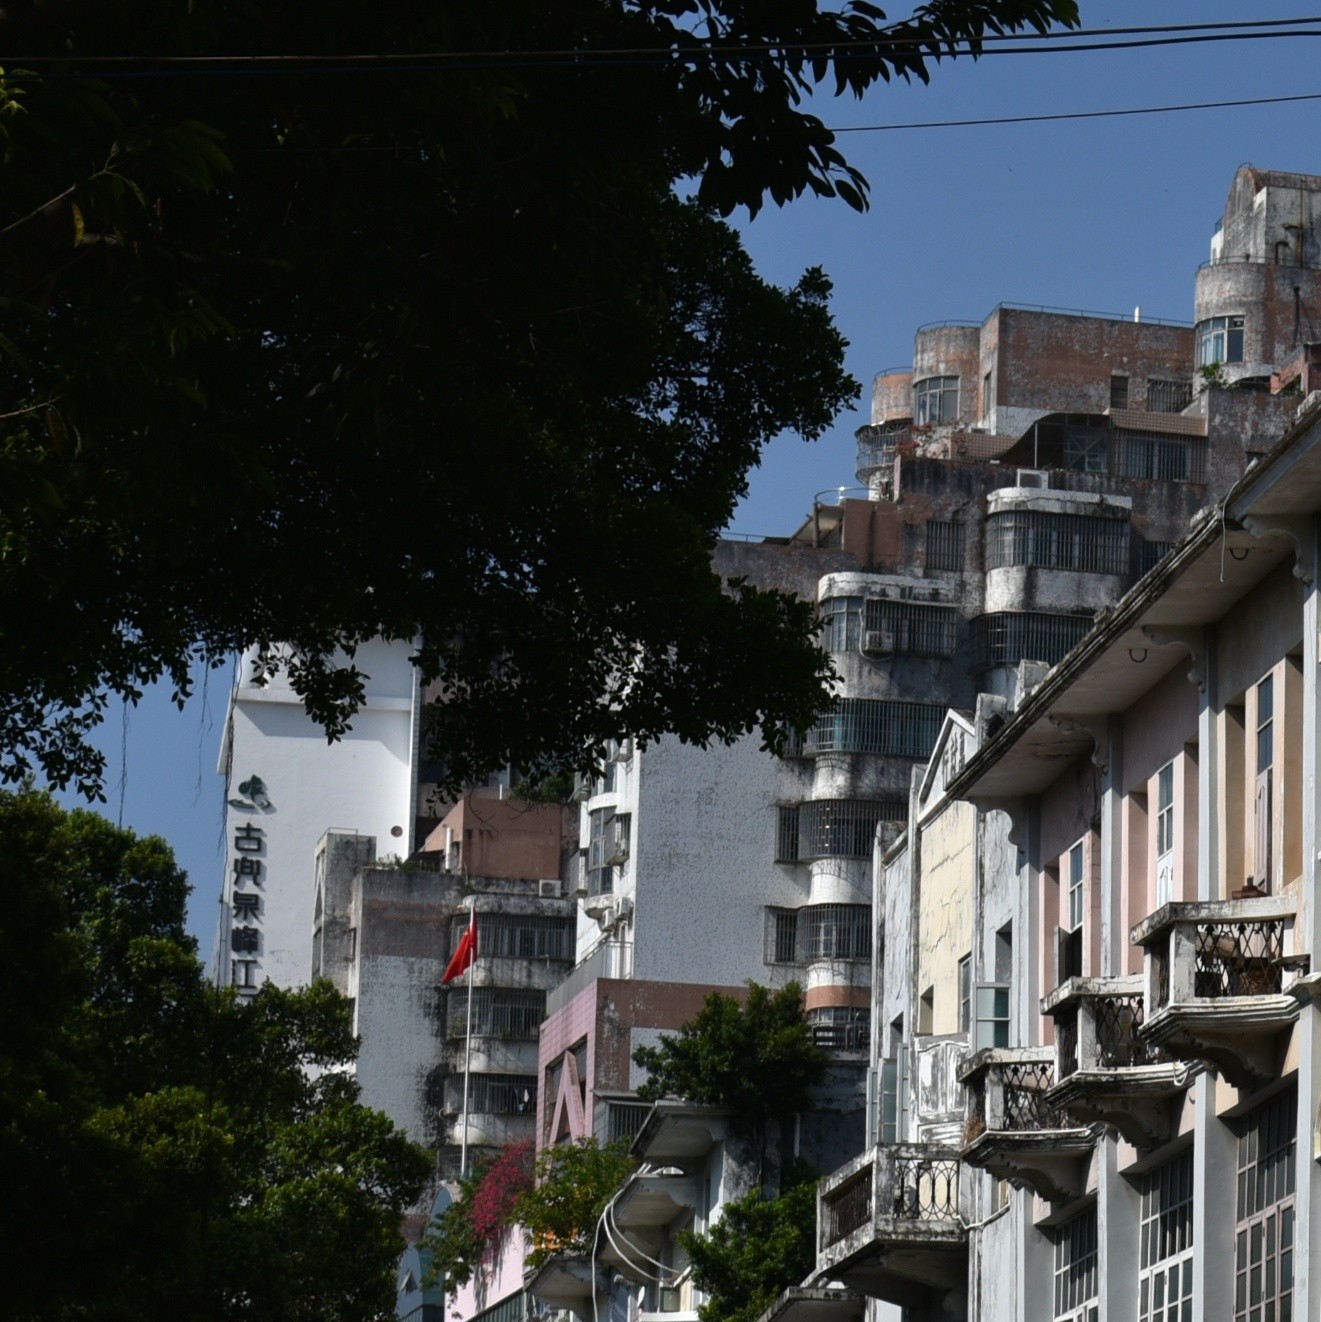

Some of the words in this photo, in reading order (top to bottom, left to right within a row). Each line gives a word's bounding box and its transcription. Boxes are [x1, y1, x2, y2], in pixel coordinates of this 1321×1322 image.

[231, 822, 262, 998] 古兜泉峰江
